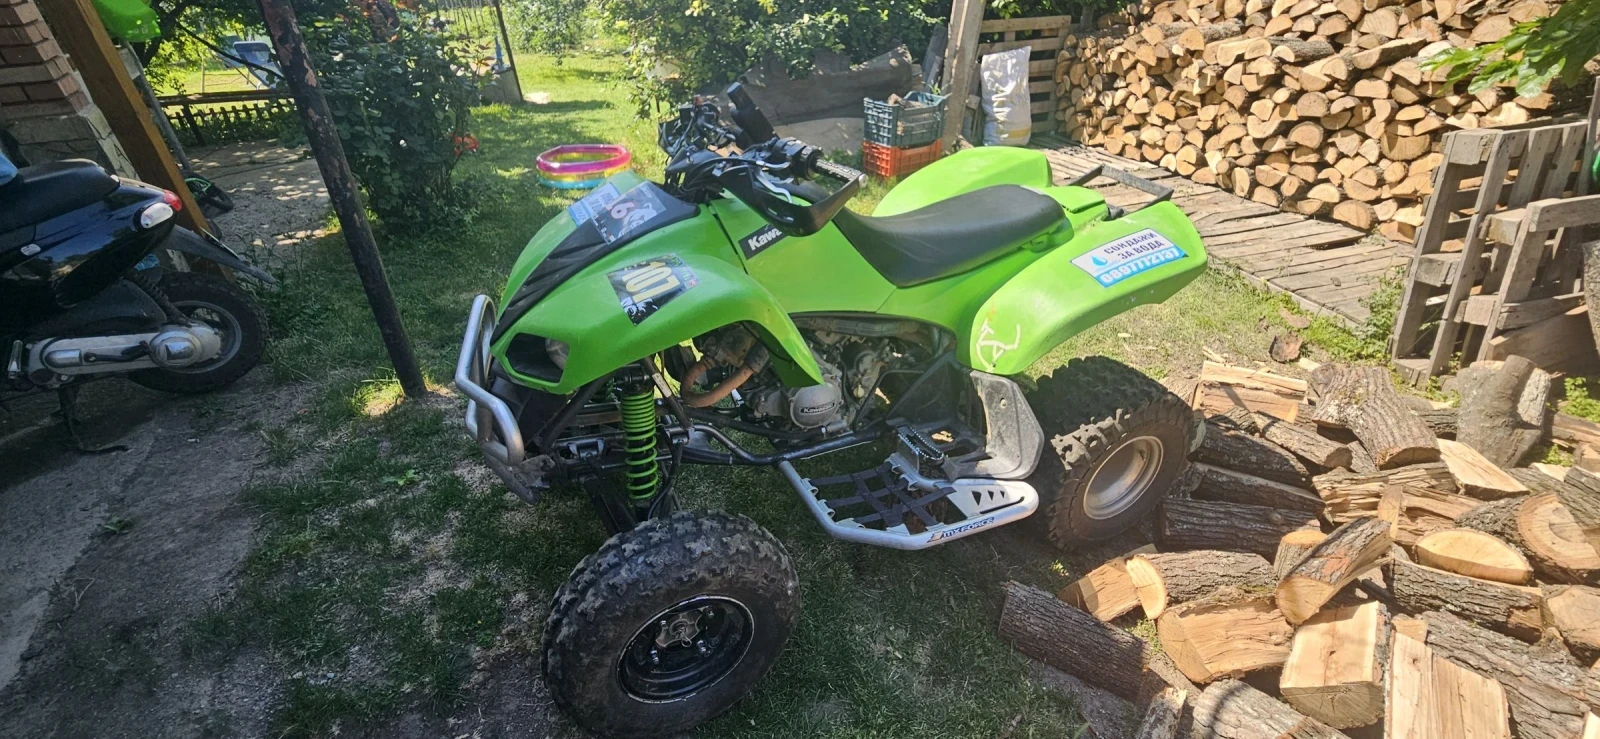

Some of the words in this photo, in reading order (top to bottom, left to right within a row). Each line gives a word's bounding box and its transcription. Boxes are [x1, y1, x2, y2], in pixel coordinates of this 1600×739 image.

[1103, 232, 1158, 254] СОНДАЖИ
[1117, 249, 1136, 260] ЗА
[1133, 240, 1164, 255] ВОДА
